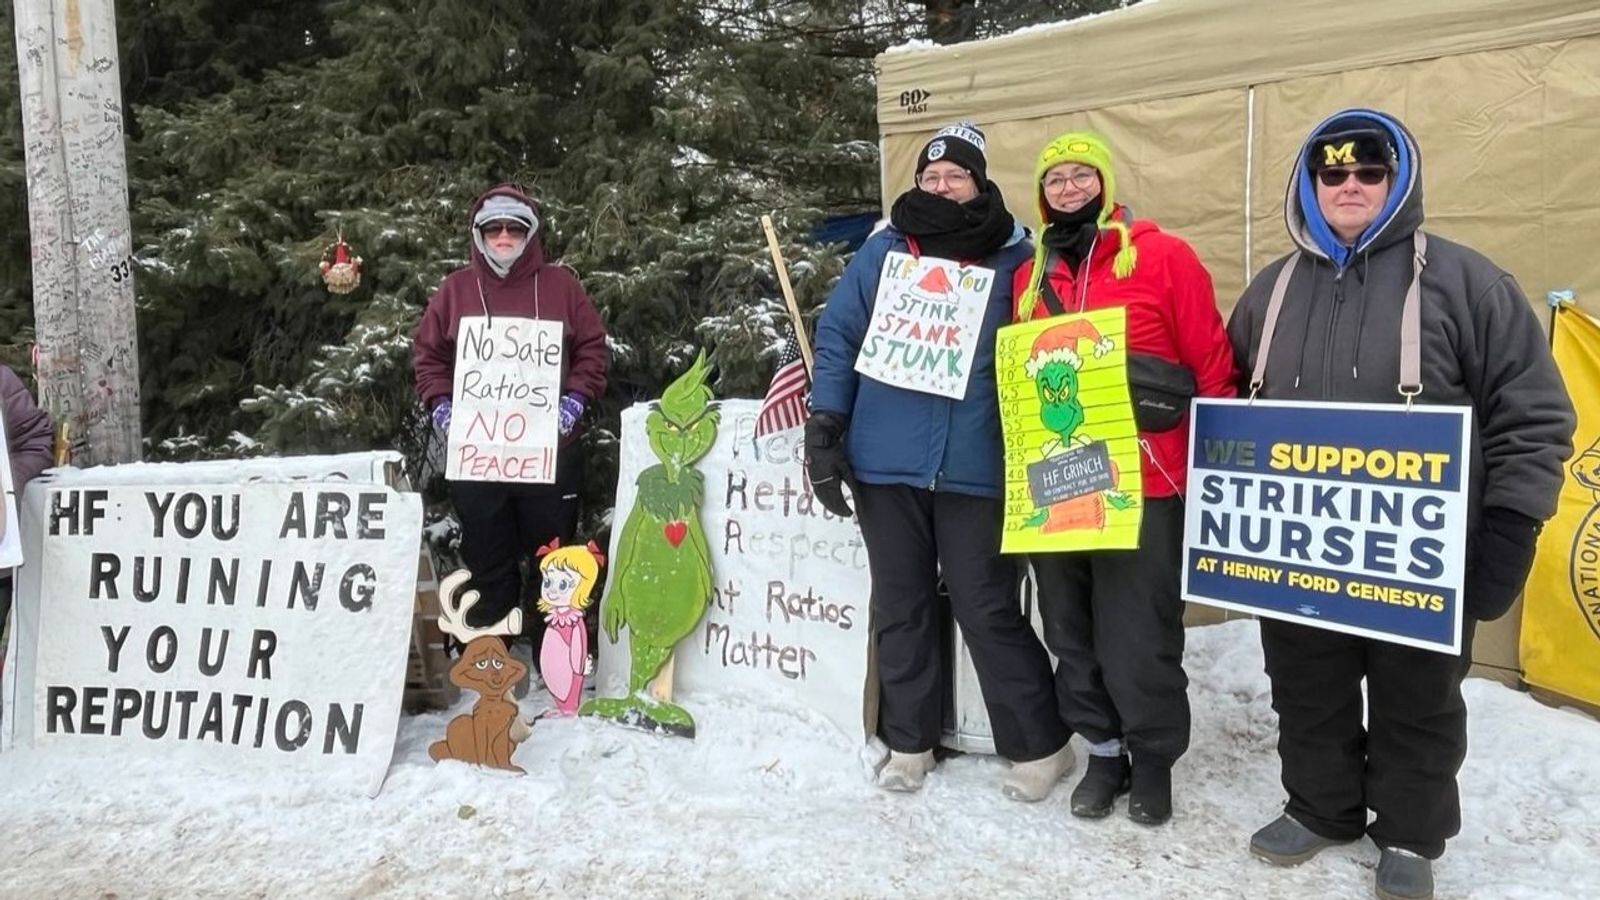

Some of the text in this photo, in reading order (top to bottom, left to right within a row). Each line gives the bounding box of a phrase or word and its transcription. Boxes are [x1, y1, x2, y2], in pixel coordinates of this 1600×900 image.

[900, 89, 921, 107] GO
[907, 103, 928, 115] FAST
[1323, 141, 1357, 166] M
[957, 269, 988, 292] YOU
[893, 293, 959, 322] STINK
[463, 323, 560, 367] No Safe
[878, 313, 962, 347] STANK
[862, 335, 963, 379] STUNK
[461, 370, 552, 412] Ratios,
[466, 410, 526, 442] NO
[458, 444, 554, 479] PEACE!!
[1042, 468, 1059, 488] HF
[1063, 454, 1103, 481] GRINCH
[1204, 438, 1450, 483] WE SUPPORT
[144, 492, 241, 541] YOU
[278, 491, 389, 540] ARE
[1200, 474, 1446, 531] STRIKING
[1200, 509, 1445, 579] NURSES
[88, 552, 379, 613] RUINING
[1196, 557, 1217, 572] AT
[1222, 560, 1282, 584] HENRY
[1288, 572, 1340, 594] FORD
[1346, 582, 1445, 612] GENESYS
[766, 580, 855, 630] Ratios
[100, 625, 278, 680] YOUR
[705, 620, 817, 680] Matter
[46, 686, 365, 755] REPUTATION
